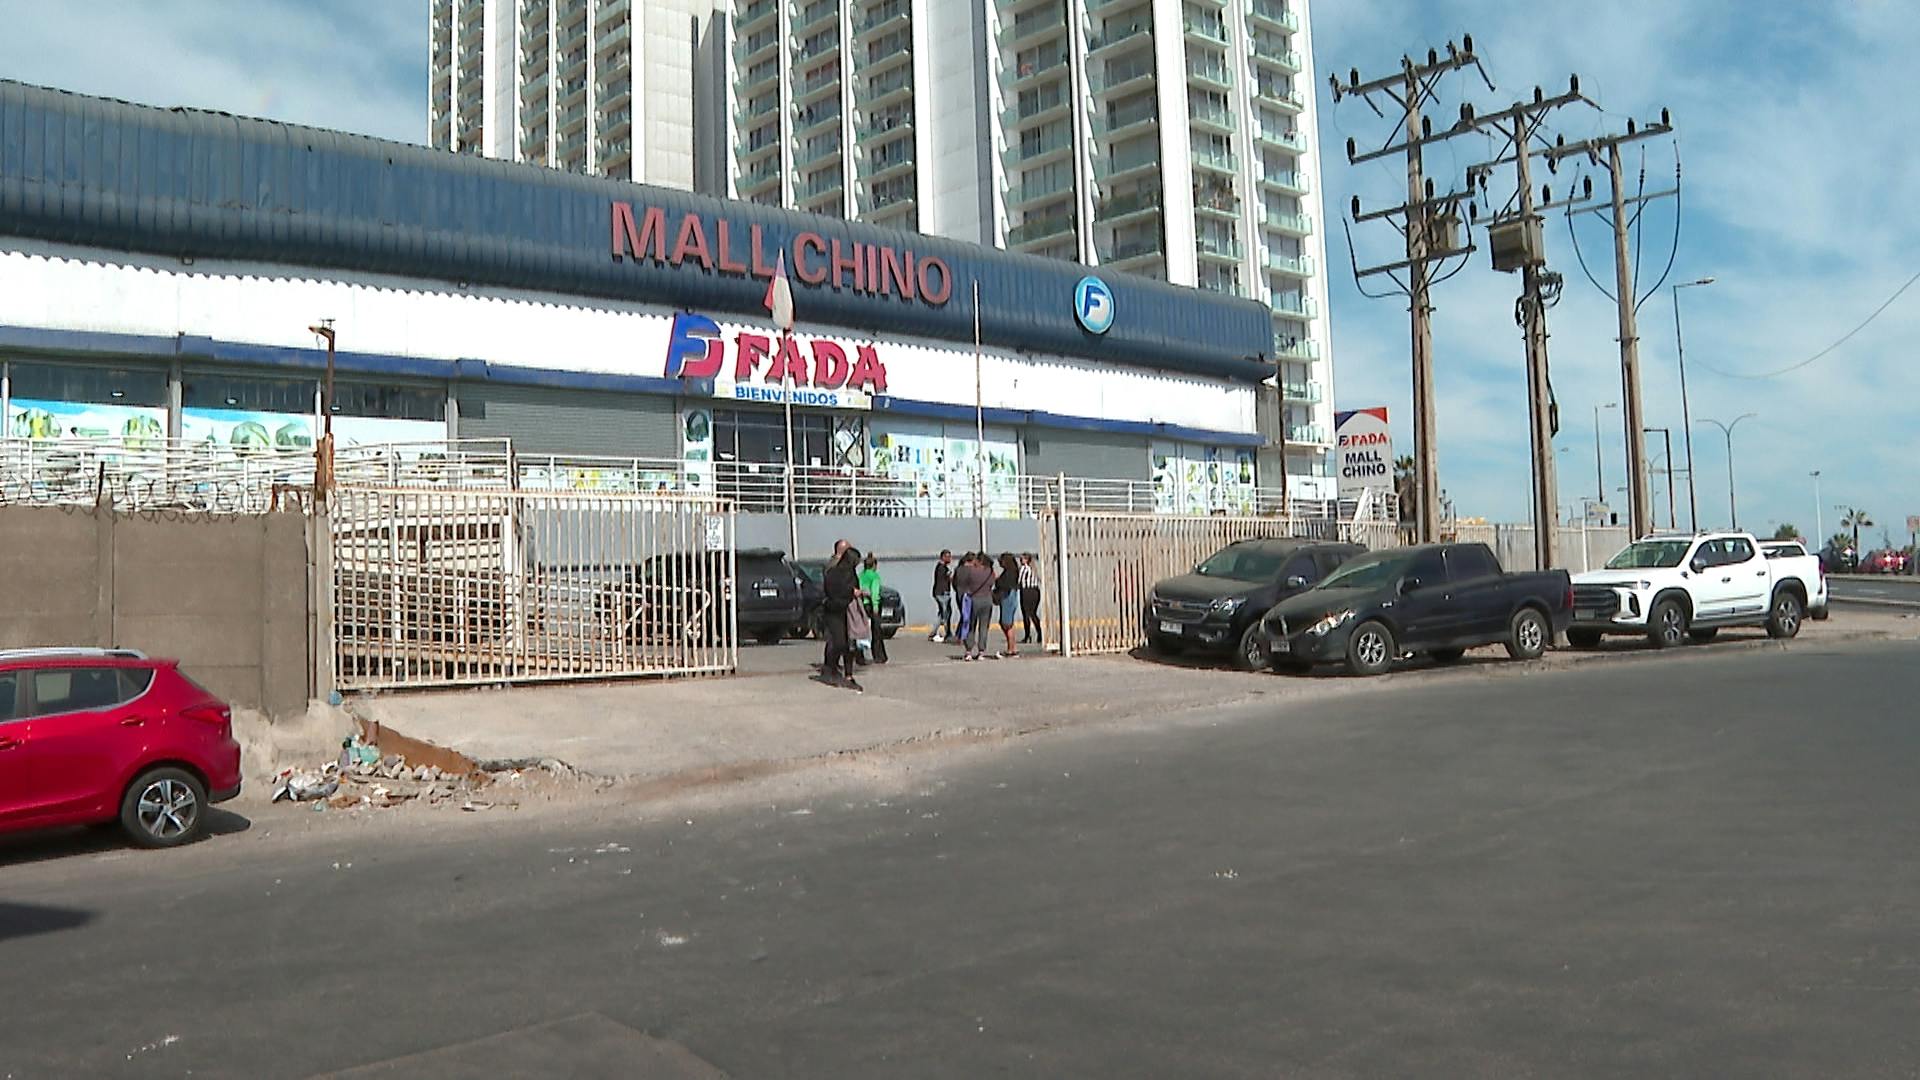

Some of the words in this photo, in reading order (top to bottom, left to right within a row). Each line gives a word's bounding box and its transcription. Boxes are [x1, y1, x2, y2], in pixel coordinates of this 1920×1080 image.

[611, 201, 775, 278] MALL
[793, 232, 952, 304] CHINO
[735, 332, 887, 394] FADA
[735, 386, 838, 406] BIENVENIDOS
[1351, 432, 1387, 446] FADA
[1345, 451, 1382, 464] MALL
[1342, 463, 1386, 478] CHINO
